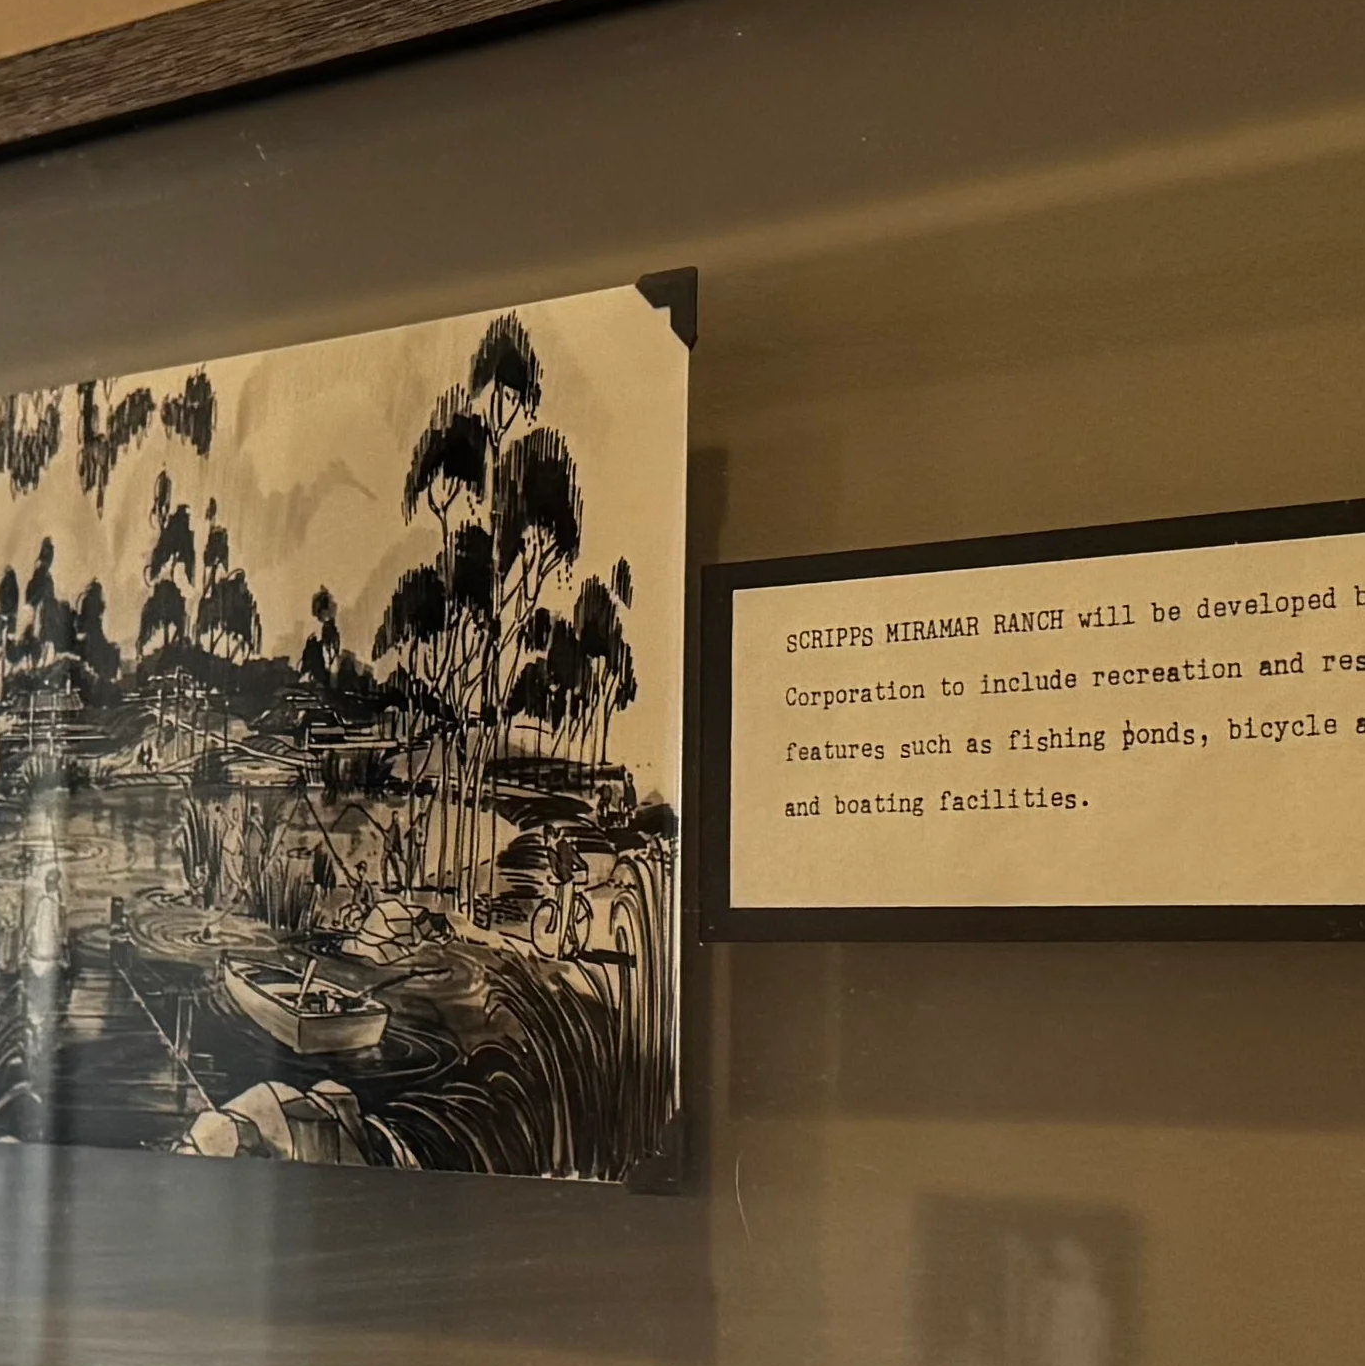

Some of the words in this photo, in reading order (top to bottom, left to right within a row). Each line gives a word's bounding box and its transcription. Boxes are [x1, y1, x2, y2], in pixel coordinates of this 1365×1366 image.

[786, 626, 874, 654] SCRIPPS
[885, 616, 980, 644] MIRAMAR
[993, 608, 1066, 635] RANCH
[1077, 604, 1136, 629] will
[1150, 601, 1181, 623] be
[1196, 586, 1338, 620] developed
[785, 680, 926, 711] Corporation
[940, 677, 965, 697] to
[979, 668, 1078, 695] include
[1091, 657, 1243, 688] recreation
[1258, 651, 1305, 677] and
[785, 740, 885, 762] features
[899, 733, 953, 759] such
[966, 737, 992, 755] as
[1008, 726, 1106, 753] fishing
[1121, 719, 1208, 752] ponds,
[1226, 713, 1338, 743] bicycle
[784, 795, 821, 818] and
[833, 792, 925, 818] boating
[939, 786, 1089, 812] facilities.
